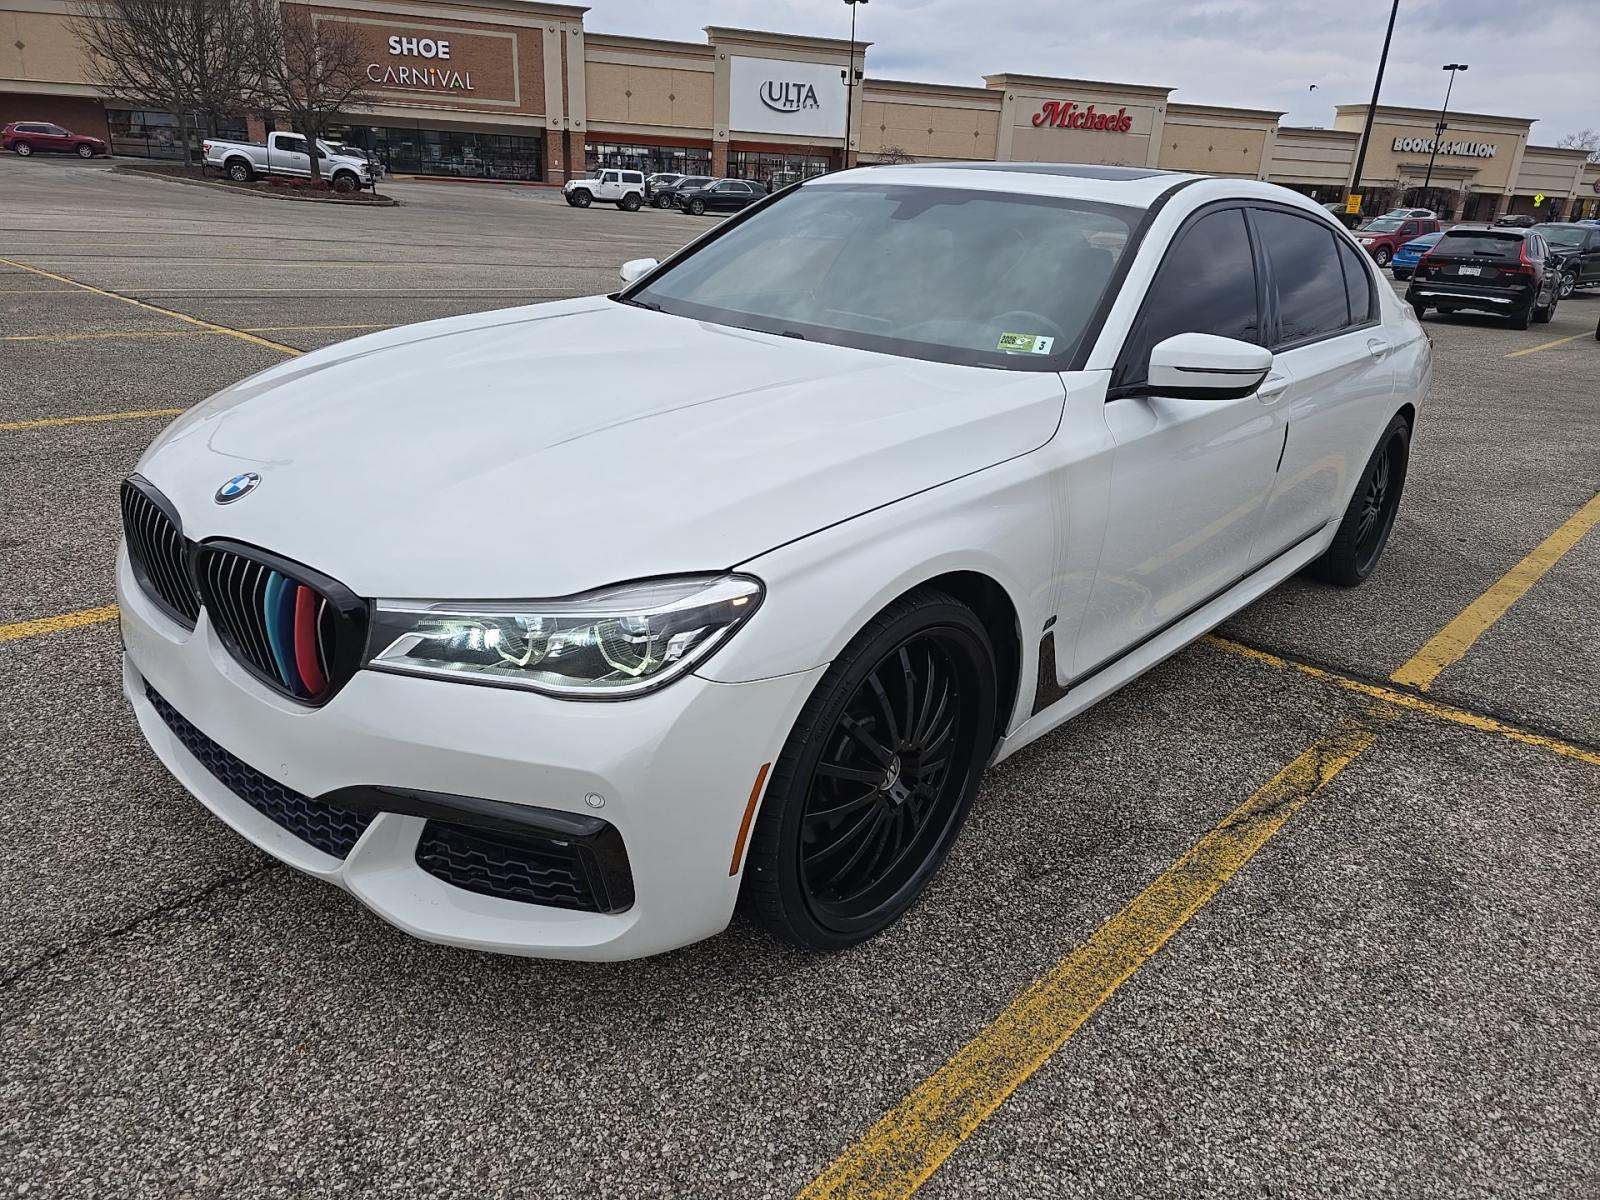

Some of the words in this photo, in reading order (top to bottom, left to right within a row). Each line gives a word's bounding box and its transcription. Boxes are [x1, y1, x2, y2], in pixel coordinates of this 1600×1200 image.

[388, 35, 450, 59] SHOE
[768, 80, 819, 105] ULTA
[1032, 101, 1133, 132] Michaels
[1039, 341, 1046, 350] 3
